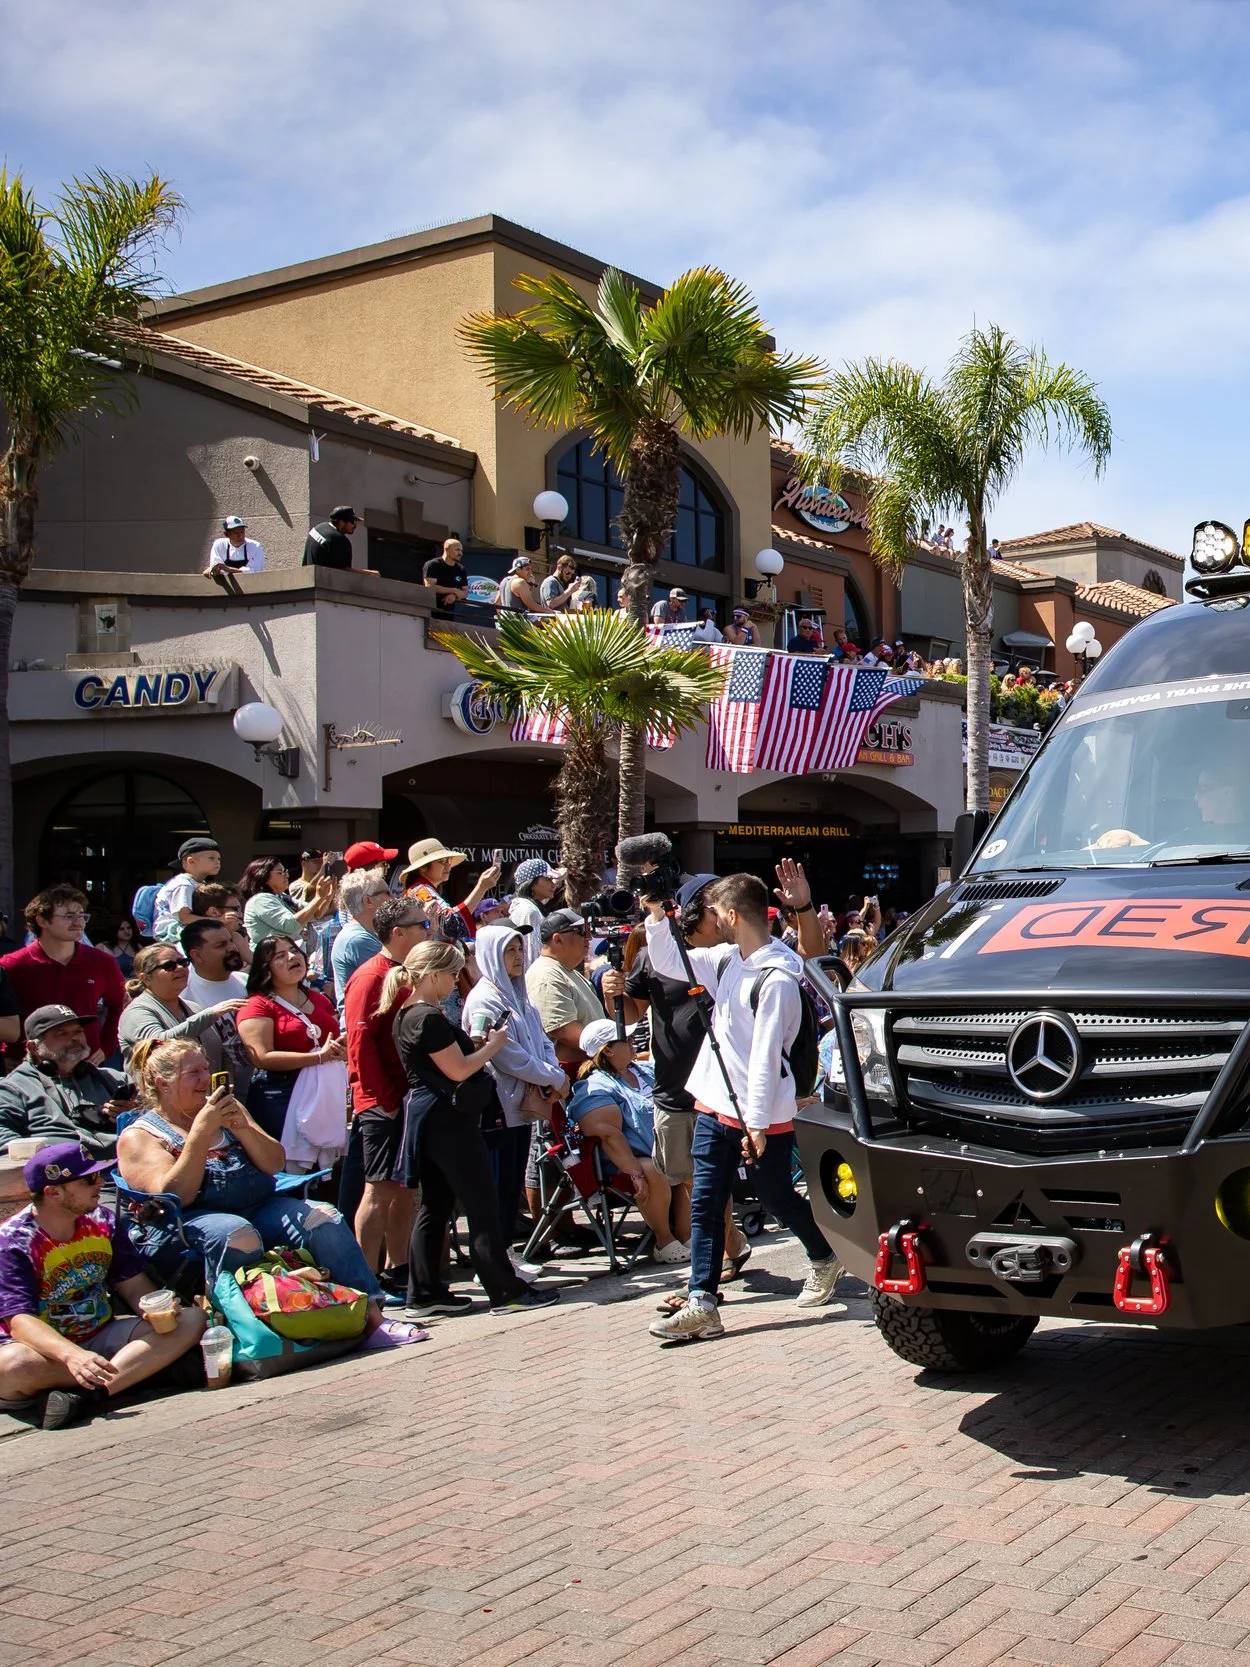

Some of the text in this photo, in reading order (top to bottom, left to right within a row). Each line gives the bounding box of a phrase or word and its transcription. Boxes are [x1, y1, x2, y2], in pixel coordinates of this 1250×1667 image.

[74, 670, 218, 710] CANDY
[862, 721, 913, 750] CH'S
[728, 825, 819, 837] MEDITERRANEAN
[822, 827, 850, 837] GRILL
[481, 848, 543, 863] MUNTAIN
